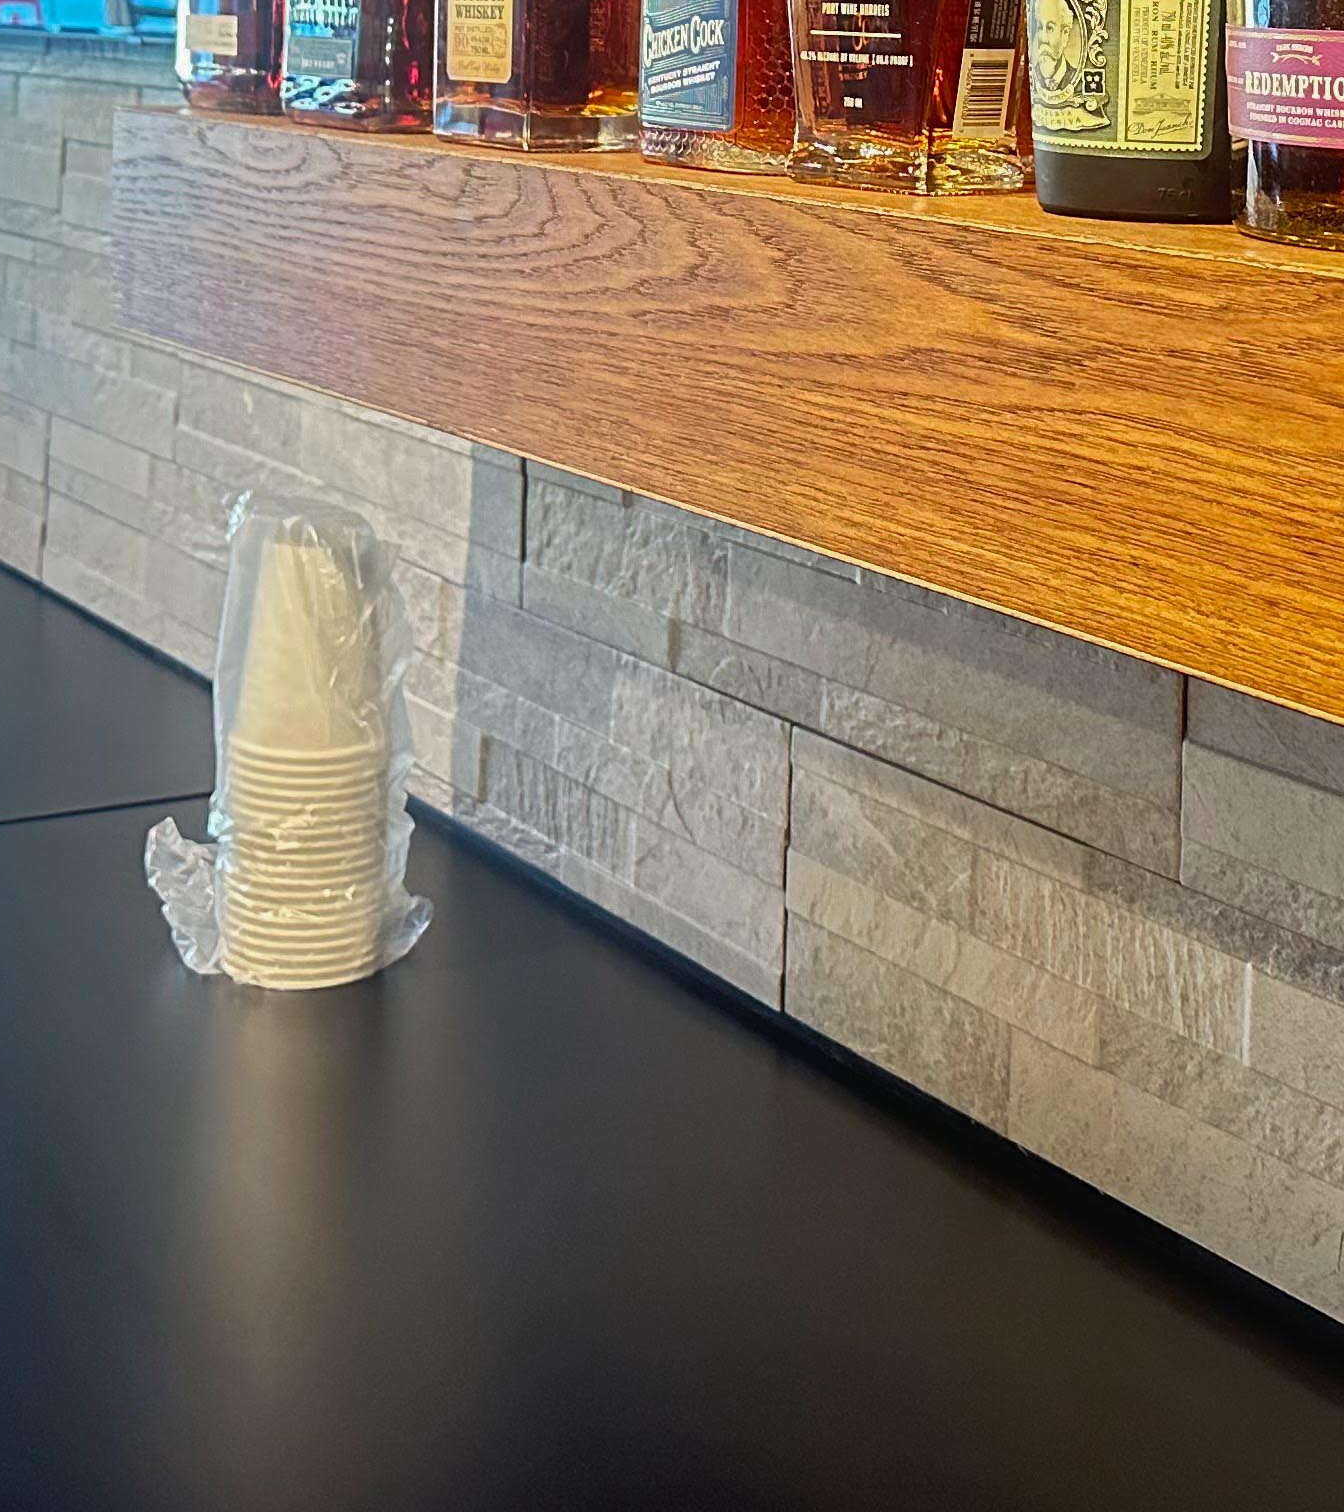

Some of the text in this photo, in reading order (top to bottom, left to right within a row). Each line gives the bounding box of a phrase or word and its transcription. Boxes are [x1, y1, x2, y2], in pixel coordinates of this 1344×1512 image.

[454, 4, 505, 21] WHISKEY
[822, 1, 840, 15] PORT
[840, 2, 858, 16] WINE
[643, 15, 725, 68] CHICKEN COCK
[1149, 0, 1160, 90] RON RUM RHUM
[682, 60, 721, 78] STRAIGHT
[1275, 102, 1314, 116] BOURBON
[1287, 115, 1323, 128] COGNAC
